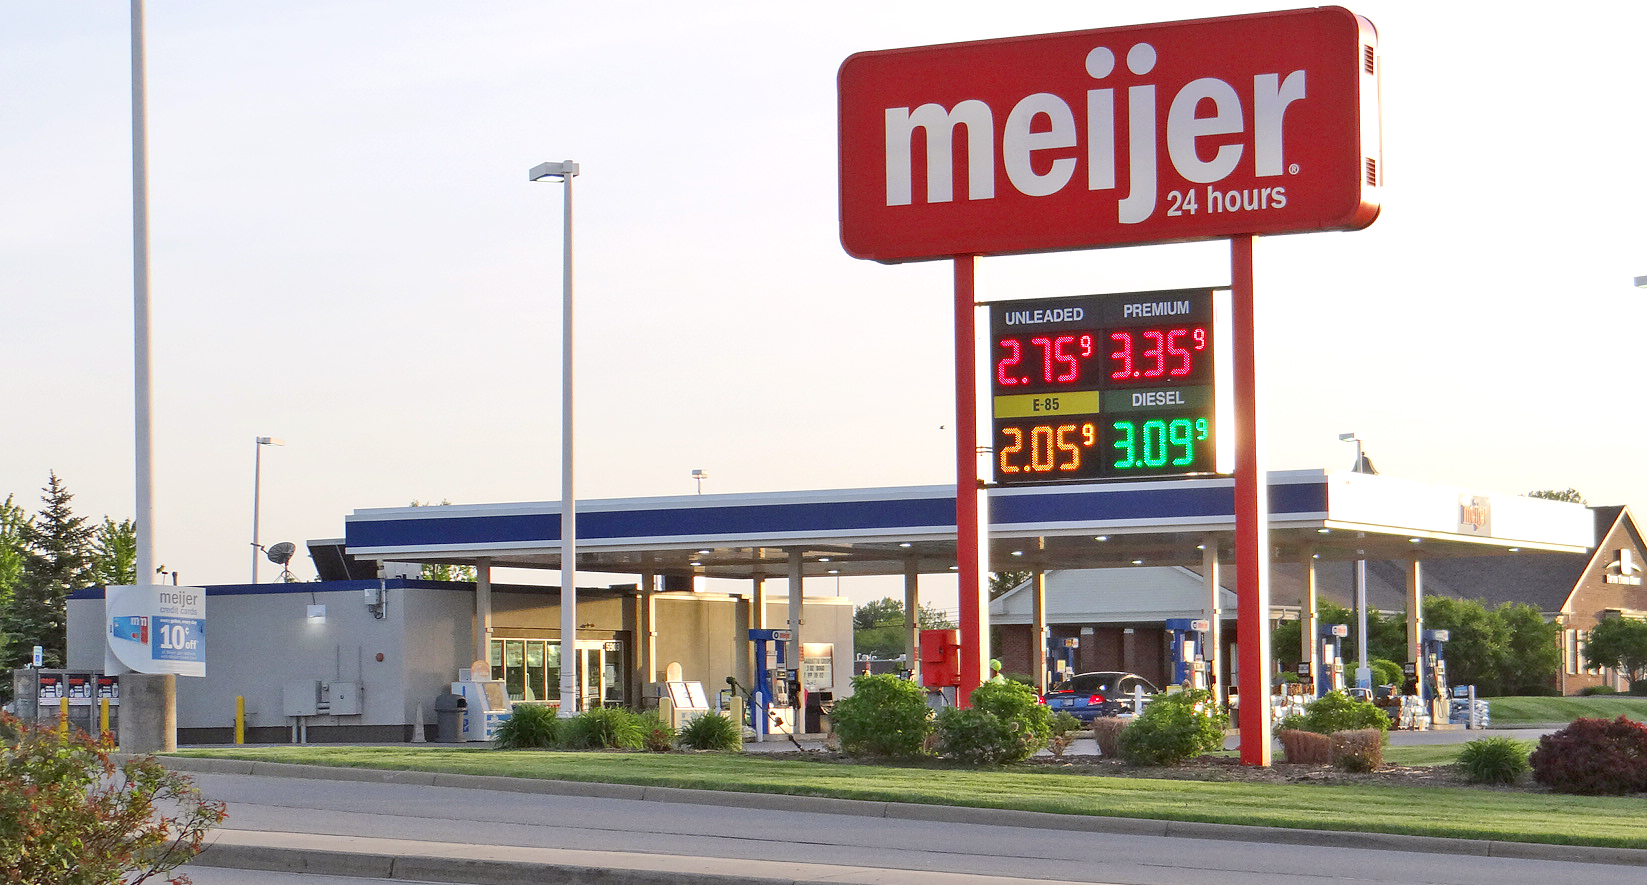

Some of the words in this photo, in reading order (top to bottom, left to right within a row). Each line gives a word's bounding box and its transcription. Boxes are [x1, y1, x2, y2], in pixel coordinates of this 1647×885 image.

[885, 42, 1306, 225] meijer
[1166, 189, 1198, 217] 24
[1207, 185, 1288, 214] hours
[1005, 307, 1084, 326] UNLEADED
[1123, 300, 1190, 318] PREMIUM
[1032, 398, 1060, 412] E-85
[1131, 391, 1185, 407] DIESEL
[160, 591, 198, 607] meijer
[185, 640, 198, 650] off
